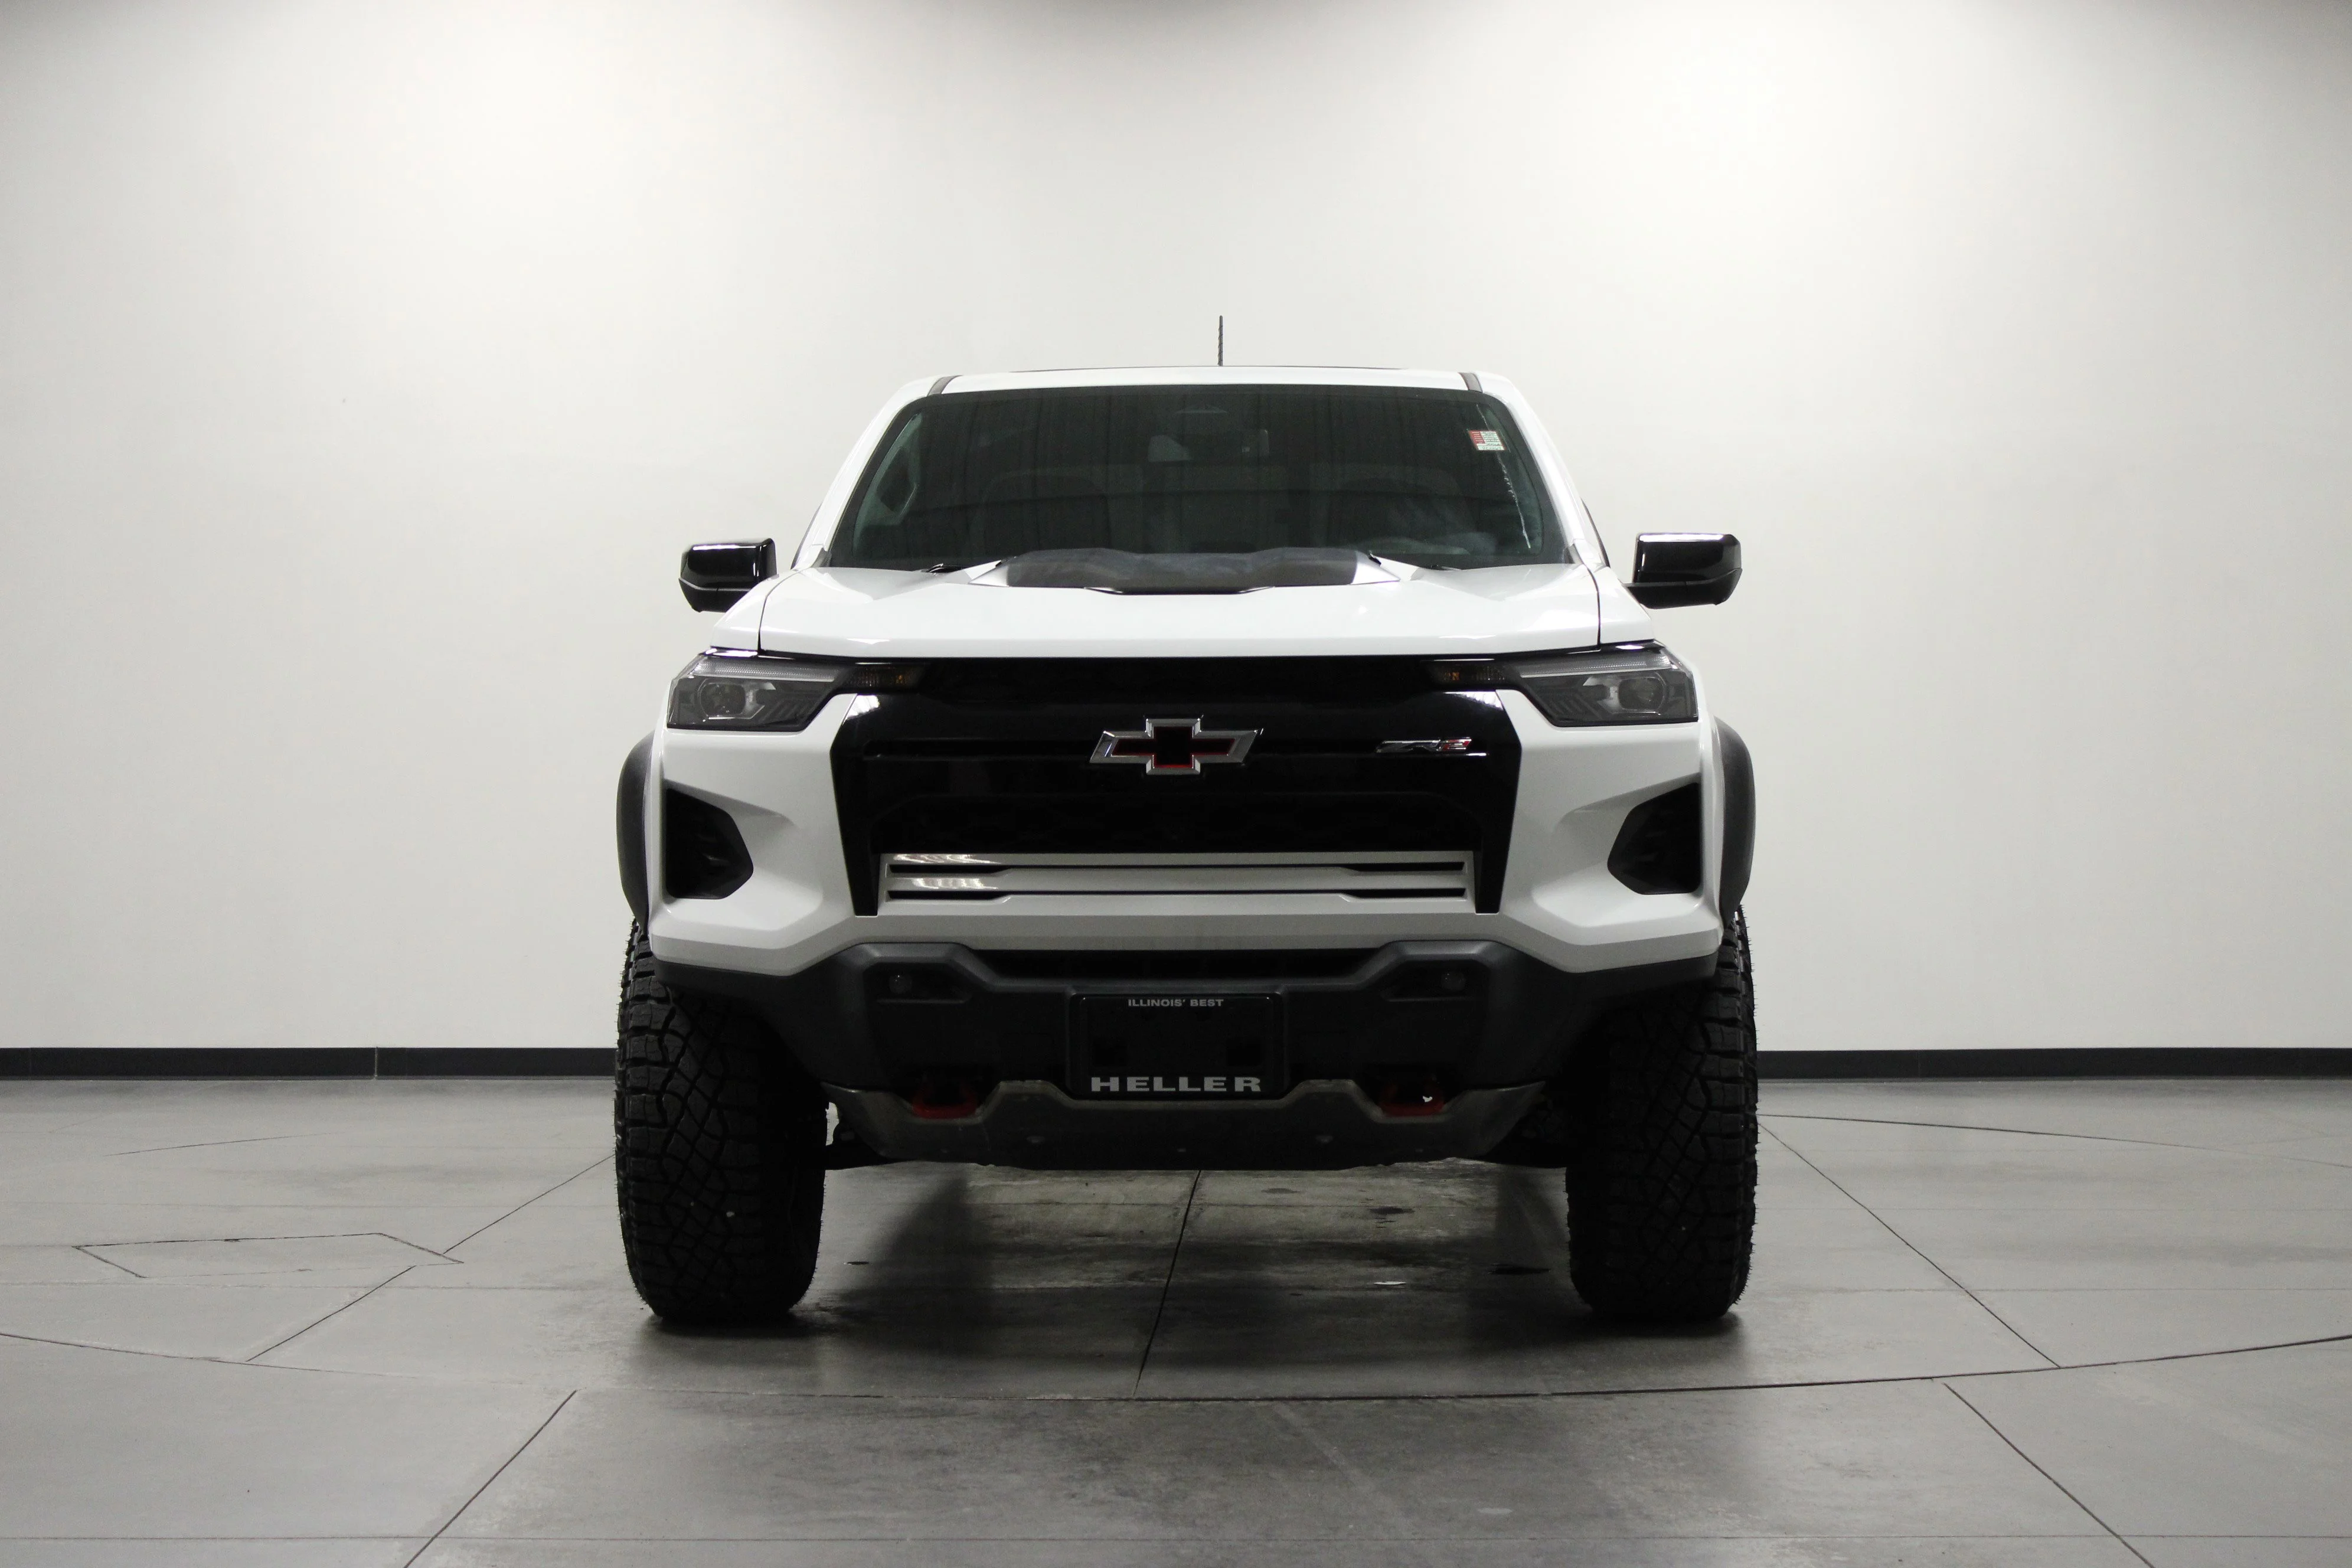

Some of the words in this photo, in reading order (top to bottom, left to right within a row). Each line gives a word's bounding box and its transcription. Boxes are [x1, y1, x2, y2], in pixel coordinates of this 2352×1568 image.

[1128, 998, 1186, 1007] ILLINOIS'
[1190, 998, 1224, 1007] BEST
[1090, 1076, 1262, 1092] HELLER
